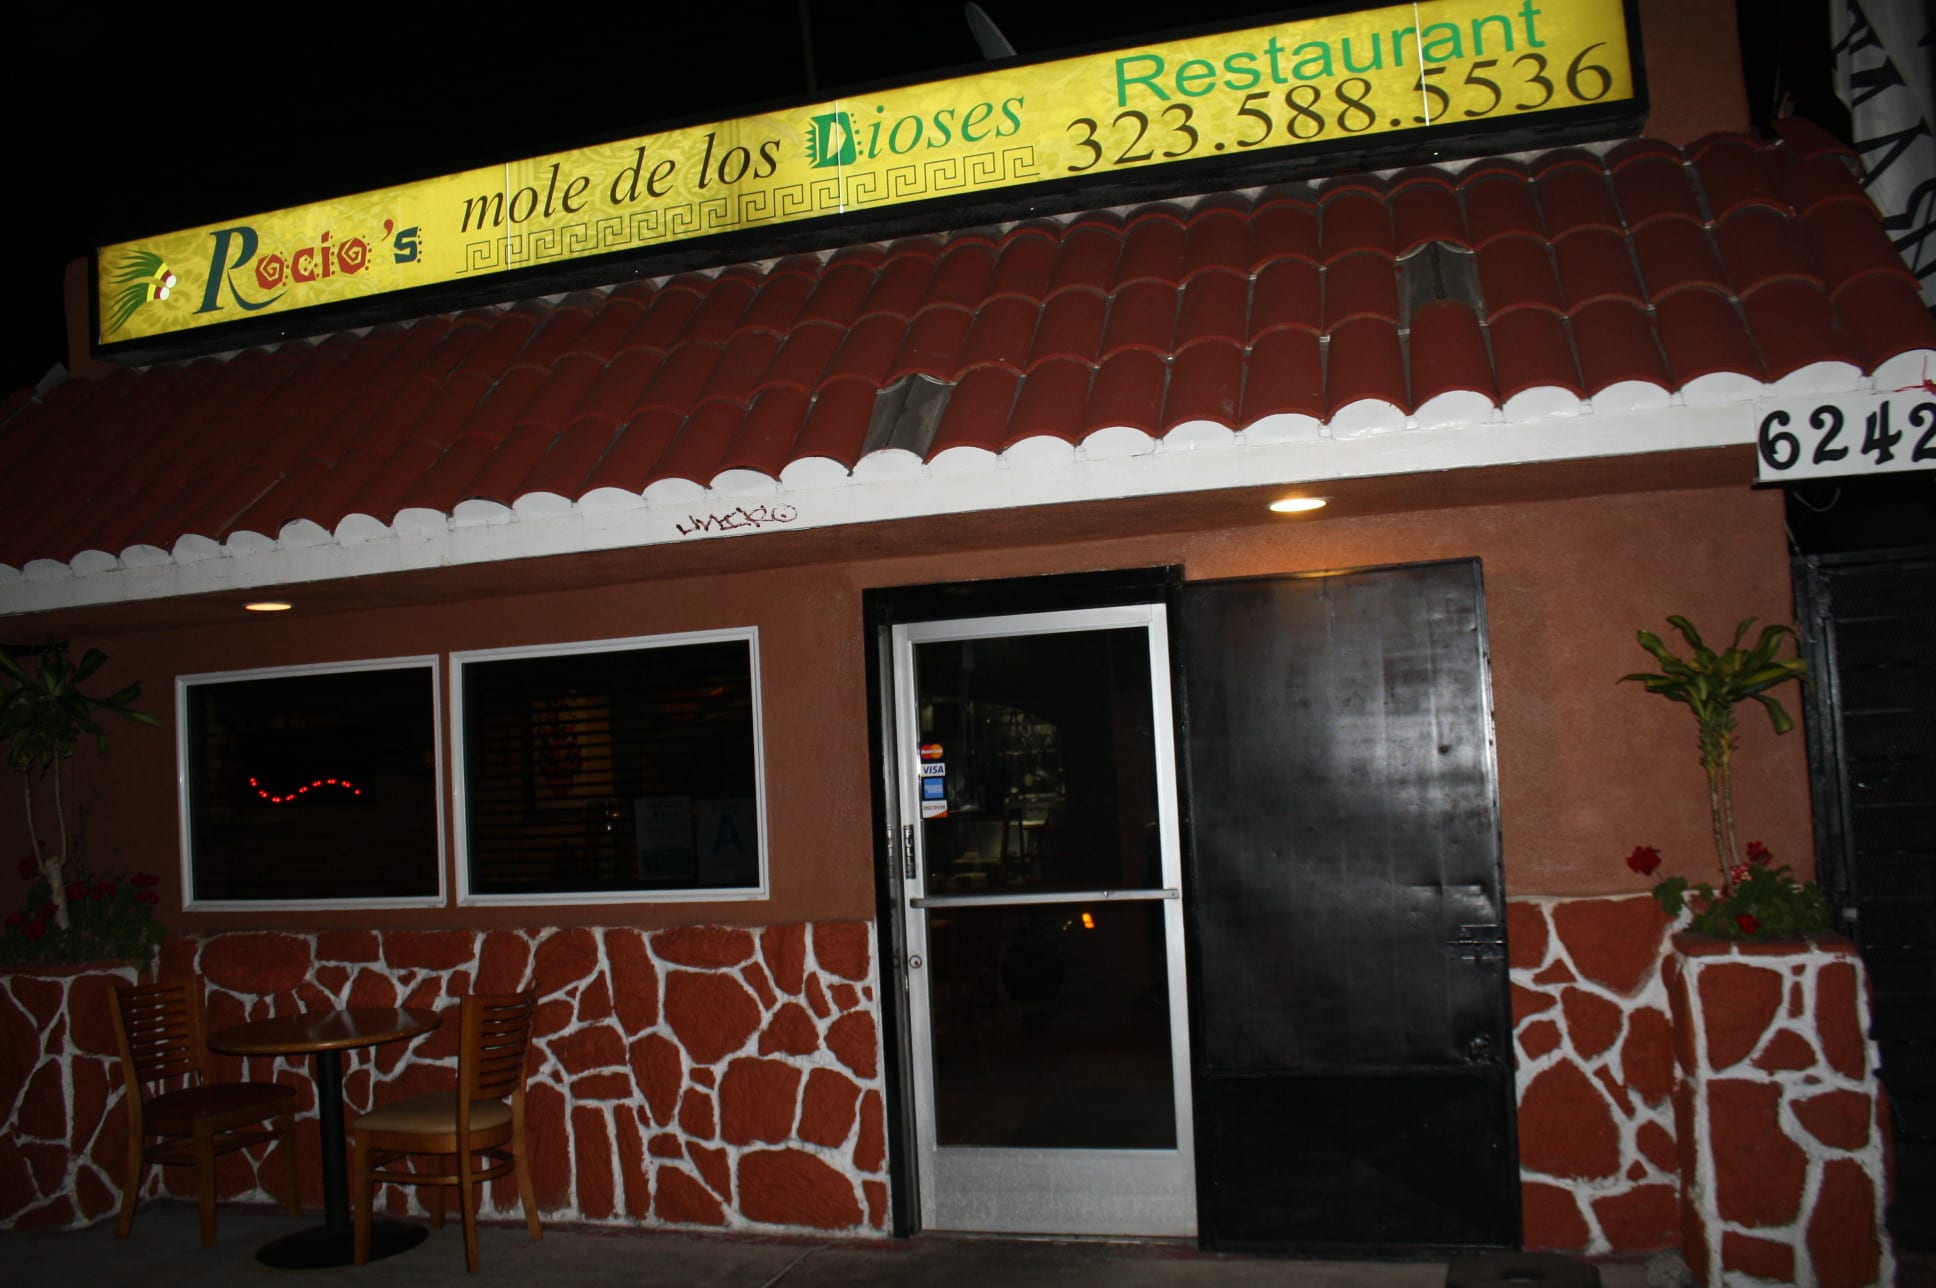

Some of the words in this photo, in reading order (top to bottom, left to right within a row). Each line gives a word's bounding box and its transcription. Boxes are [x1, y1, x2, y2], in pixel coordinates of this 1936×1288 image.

[1065, 42, 1613, 172] 323.588.5536
[1115, 0, 1545, 107] Restaurant
[192, 218, 424, 316] Rocio's
[461, 162, 590, 233] mole
[609, 146, 676, 204] de
[698, 132, 781, 190] los
[804, 95, 1025, 169] Dioses
[1759, 401, 1936, 470] 6242
[923, 765, 944, 774] VISA
